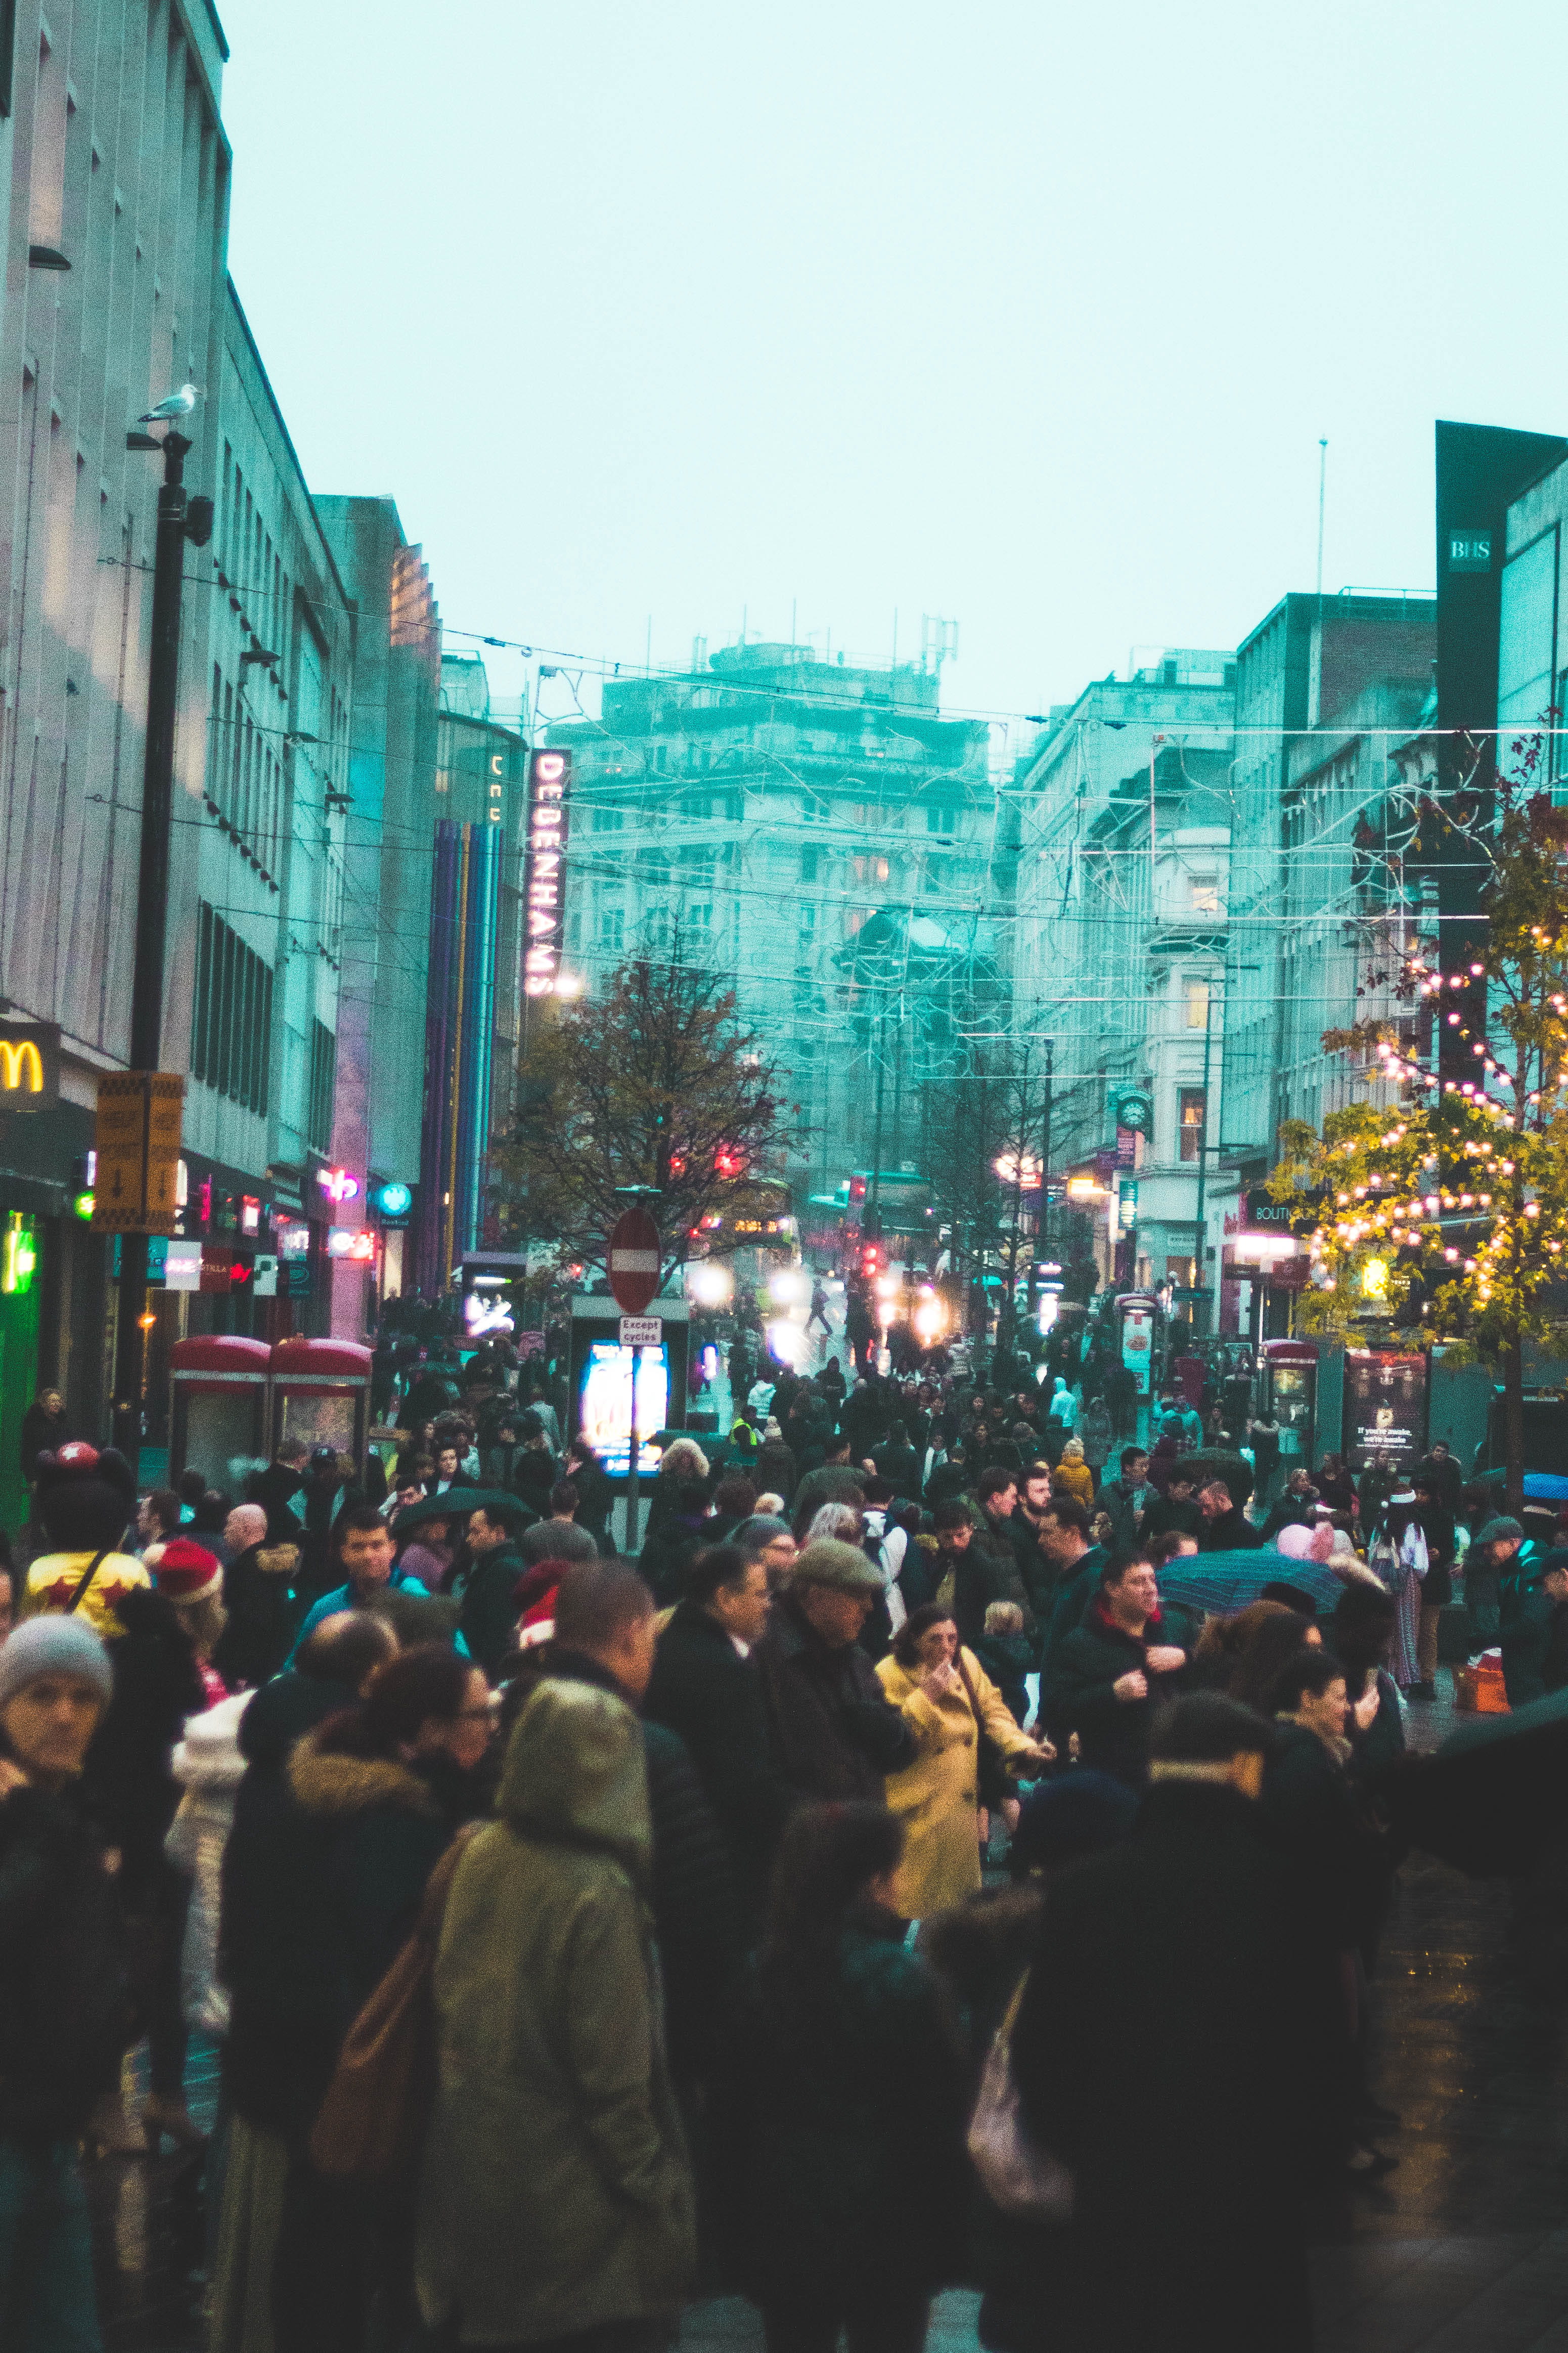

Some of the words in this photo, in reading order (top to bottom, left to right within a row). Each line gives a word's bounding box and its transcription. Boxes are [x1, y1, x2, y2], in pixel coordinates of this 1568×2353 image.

[1451, 541, 1490, 558] BHS
[525, 753, 564, 996] DEBENHAMS
[623, 1319, 658, 1330] Except
[623, 1332, 656, 1342] cycles
